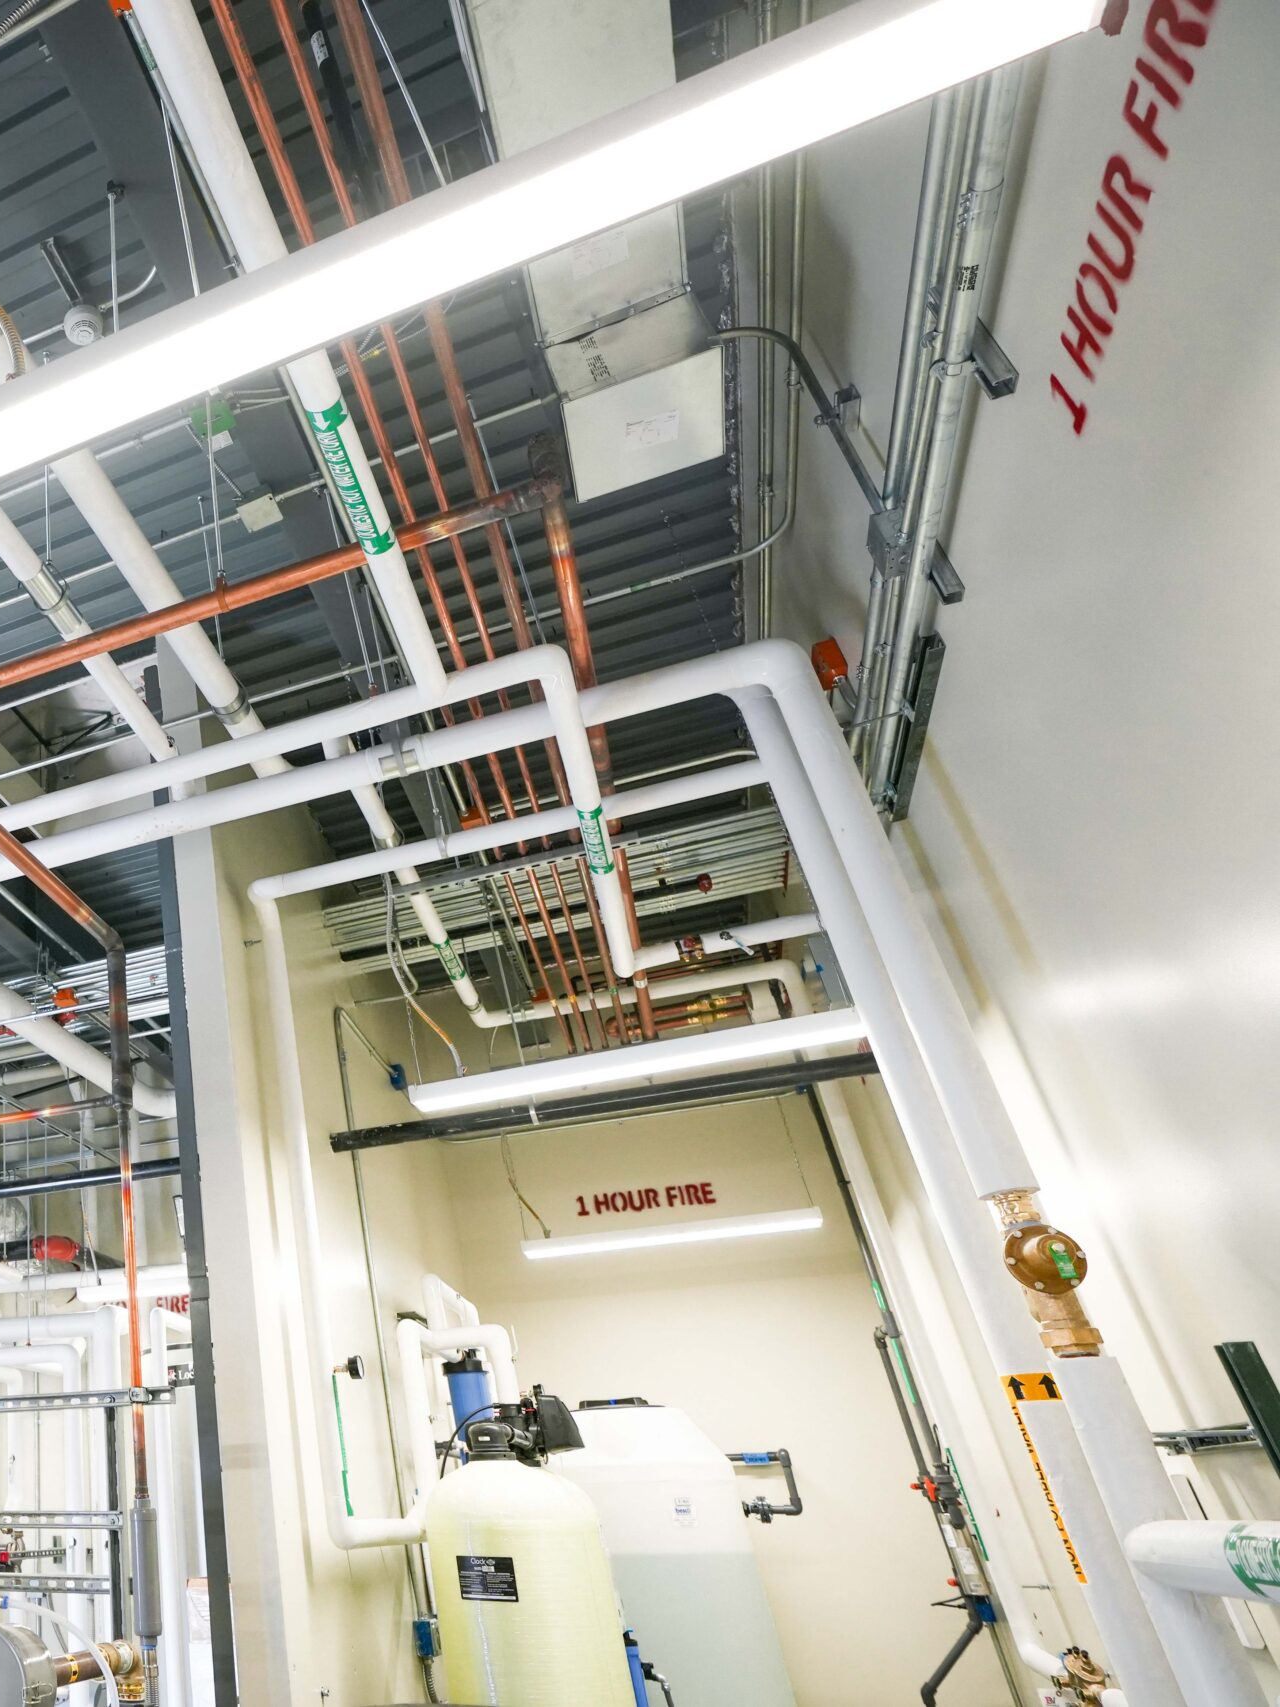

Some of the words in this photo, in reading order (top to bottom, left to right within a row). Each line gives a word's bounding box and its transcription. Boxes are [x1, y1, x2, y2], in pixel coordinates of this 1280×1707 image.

[1060, 154, 1154, 383] HOUR
[1049, 373, 1087, 435] 1
[576, 1195, 590, 1217] 1
[593, 1187, 661, 1215] HOUR
[665, 1182, 717, 1207] FIRE
